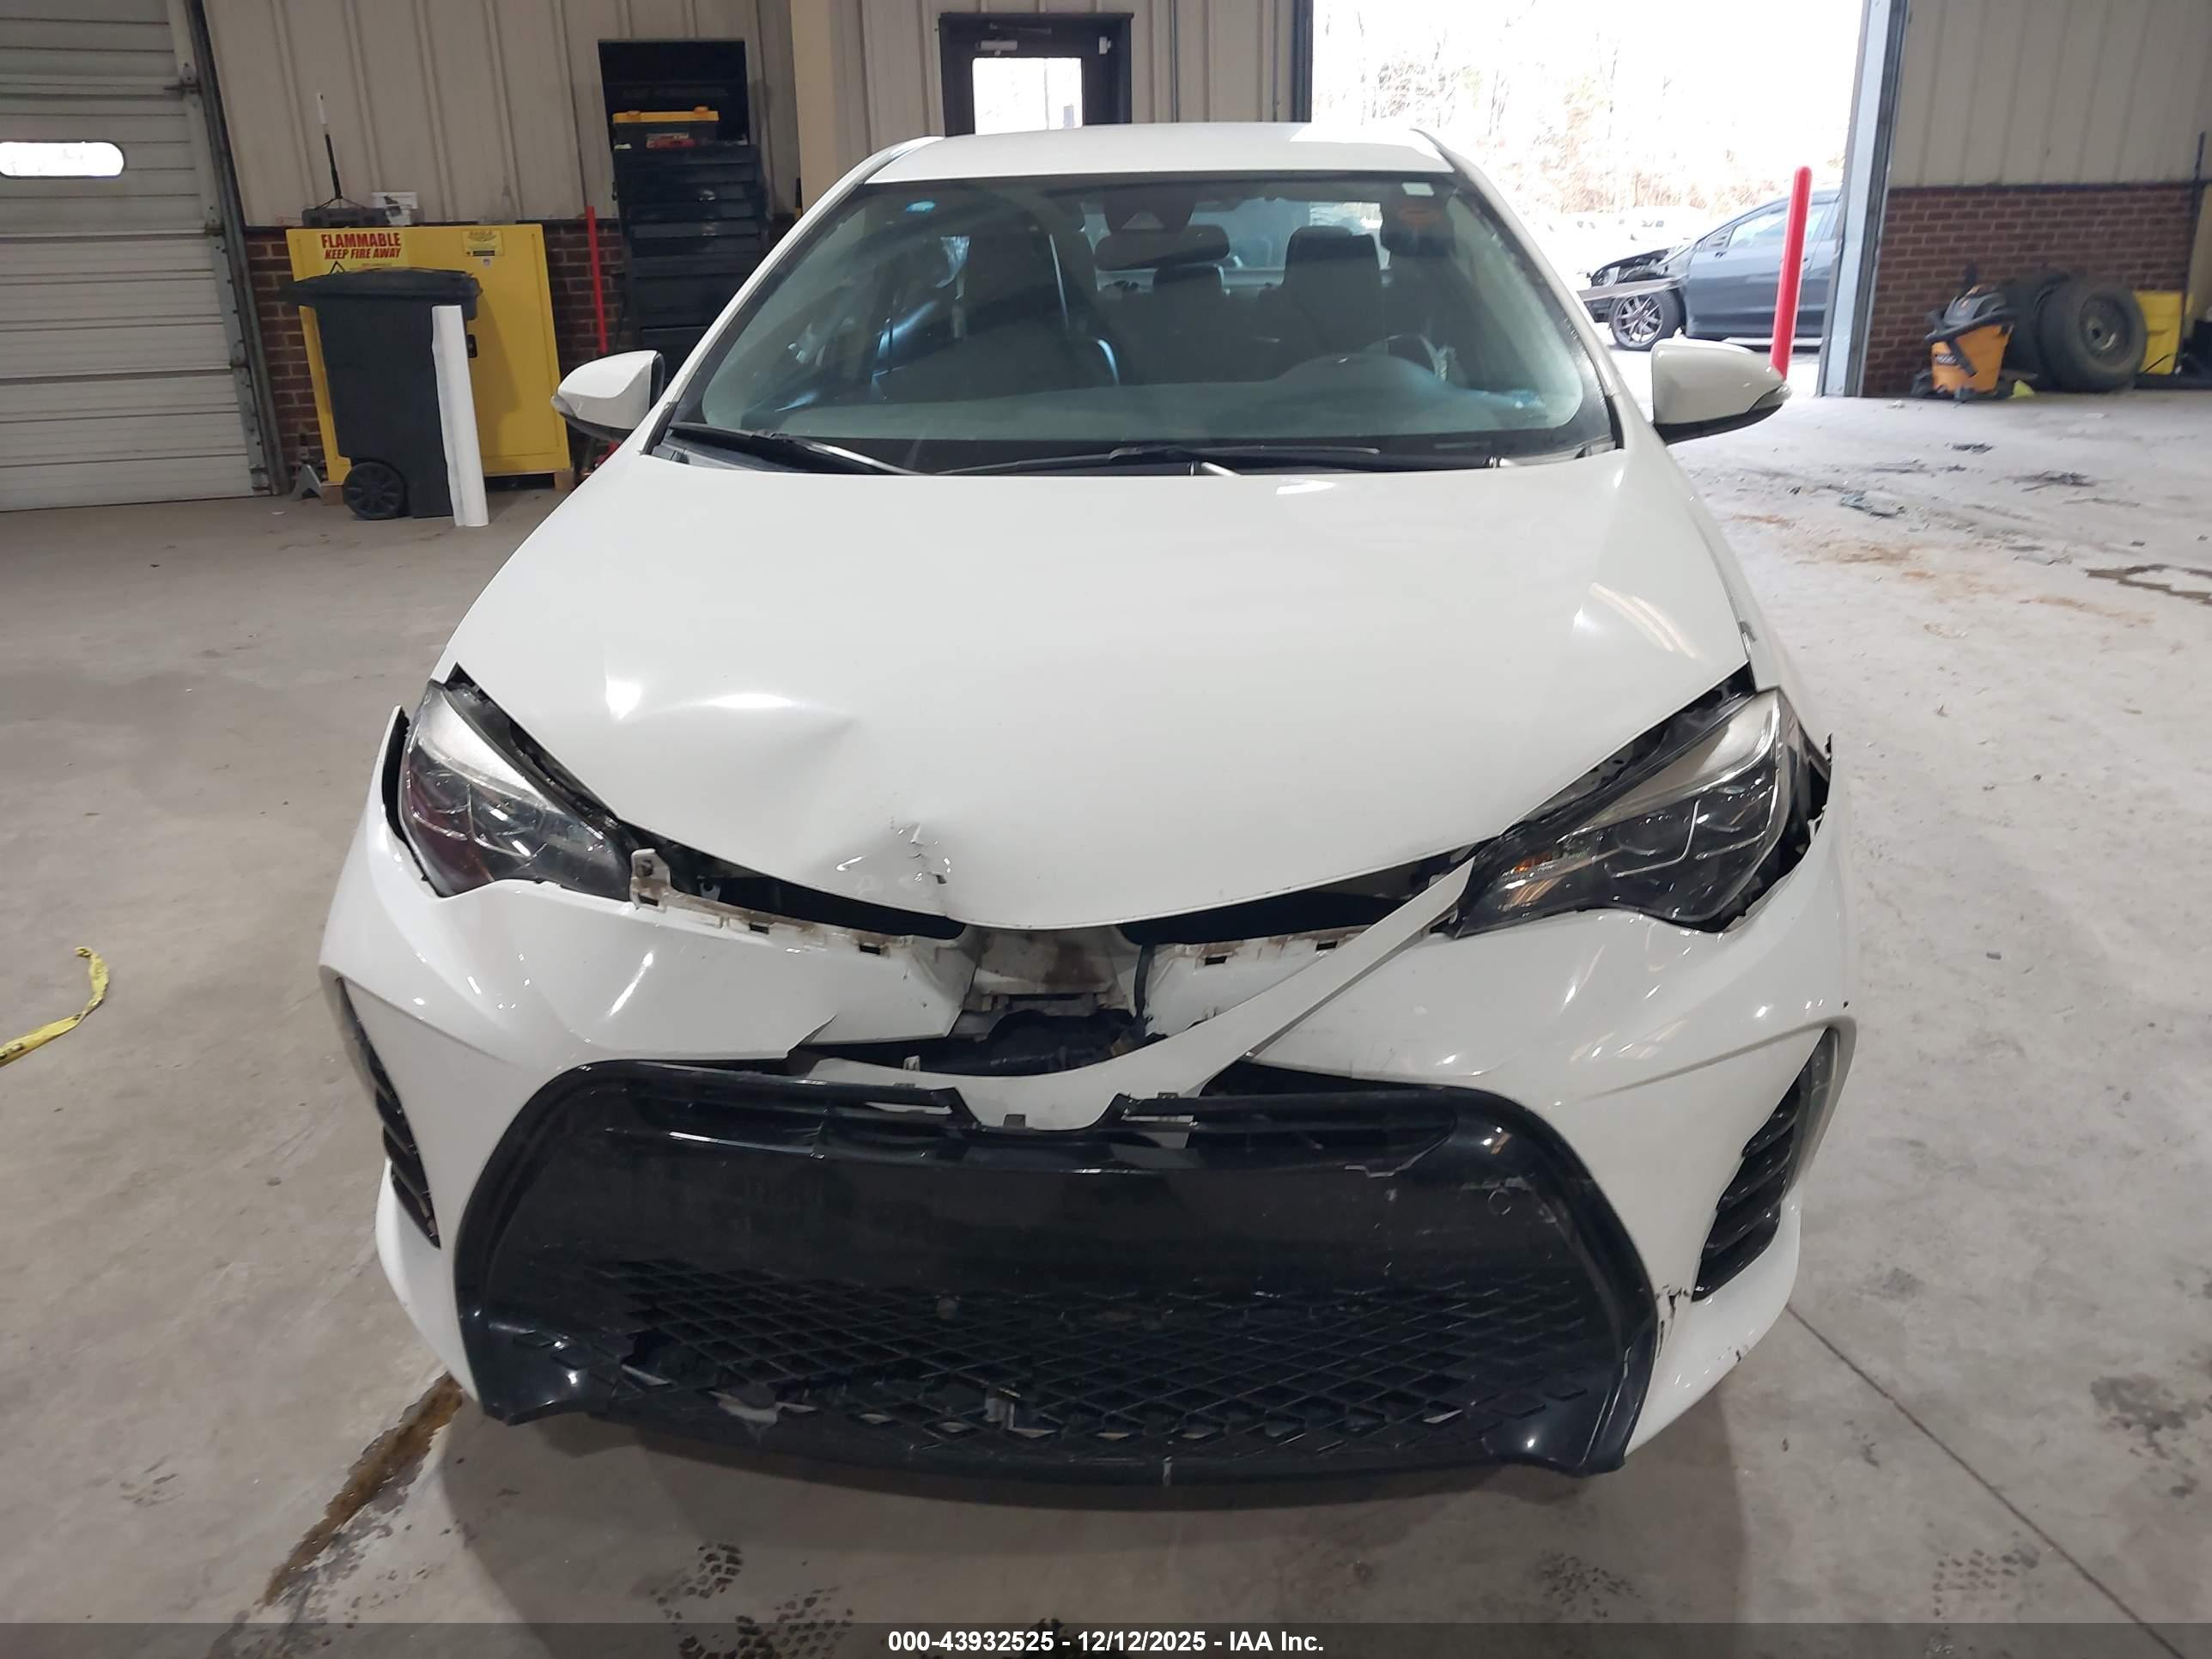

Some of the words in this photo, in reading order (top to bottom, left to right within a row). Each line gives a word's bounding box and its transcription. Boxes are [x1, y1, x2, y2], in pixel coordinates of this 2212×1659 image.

[321, 232, 401, 248] FLAMMABLE
[325, 249, 349, 259] KEEP
[350, 248, 371, 258] FIRE
[373, 247, 401, 258] AWAY
